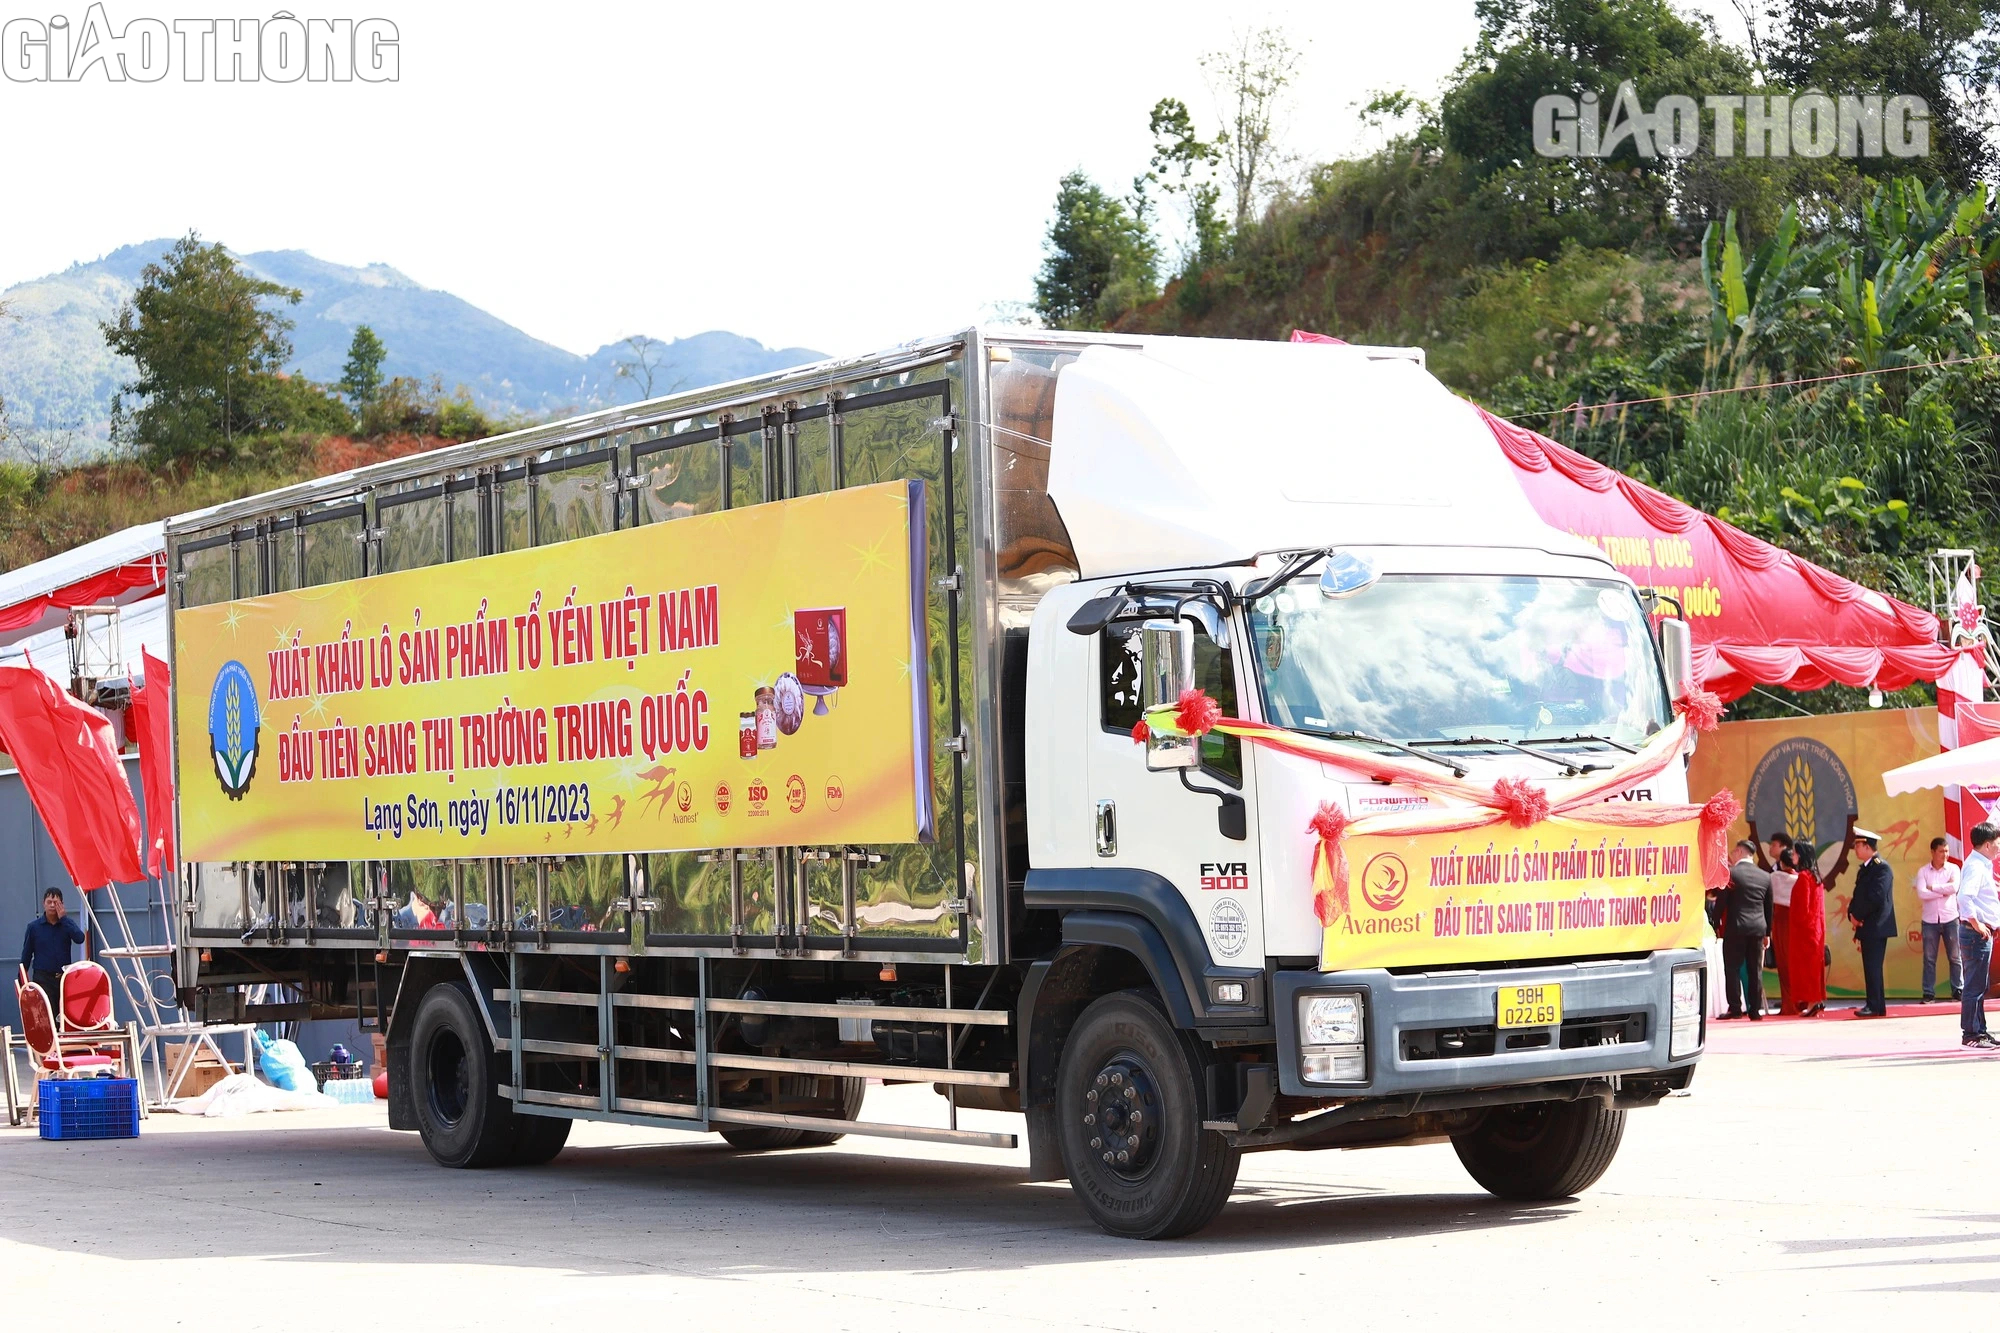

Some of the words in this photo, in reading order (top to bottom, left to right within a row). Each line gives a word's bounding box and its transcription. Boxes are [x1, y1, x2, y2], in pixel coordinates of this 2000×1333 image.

[1602, 536, 1652, 567] TRUNG
[1684, 577, 1721, 619] QUỐC
[268, 630, 310, 699] XUẤT
[316, 620, 364, 694] KHẨU
[370, 625, 392, 688] LÔ
[399, 608, 439, 685] SẢN
[446, 598, 508, 679] PHẨM
[515, 590, 541, 670] TỔ
[548, 586, 593, 666] YẾN
[600, 586, 651, 670] VIỆT
[659, 586, 718, 652] NAM
[279, 715, 314, 781] ĐẦU
[318, 718, 359, 779] TIÊN
[364, 721, 416, 777] SANG
[422, 718, 454, 783] THỊ
[460, 697, 547, 768] TRƯỜNG
[554, 699, 632, 762] TRUNG
[640, 670, 708, 762] QUỐC
[748, 786, 768, 801] ISO
[827, 786, 843, 798] FDA
[1359, 797, 1429, 805] FORWARD
[365, 797, 402, 840] Lạng
[407, 794, 443, 834] Sơn,
[449, 789, 489, 836] ngày
[496, 783, 590, 824] 16/11/2023
[1200, 863, 1247, 876] FVR
[1430, 845, 1463, 886] XUẤT
[1467, 842, 1501, 885] KHẨU
[1505, 847, 1519, 883] LÔ
[1523, 839, 1548, 882] SẢN
[1552, 839, 1587, 880] PHẨM
[1591, 837, 1607, 878] TỔ
[1609, 838, 1631, 877] YẾN
[1635, 841, 1659, 882] VIỆT
[1662, 846, 1688, 875] NAM
[1201, 877, 1248, 889] 900
[1434, 896, 1461, 937] ĐẦU
[1465, 899, 1493, 935] TIÊN
[1497, 903, 1531, 934] SANG
[1536, 902, 1554, 937] THỊ
[1558, 892, 1604, 929] TRƯỜNG
[1609, 896, 1647, 926] TRUNG
[1651, 884, 1681, 927] QUỐC
[1517, 987, 1543, 1005] 98H
[1506, 1006, 1554, 1024] 022.69
